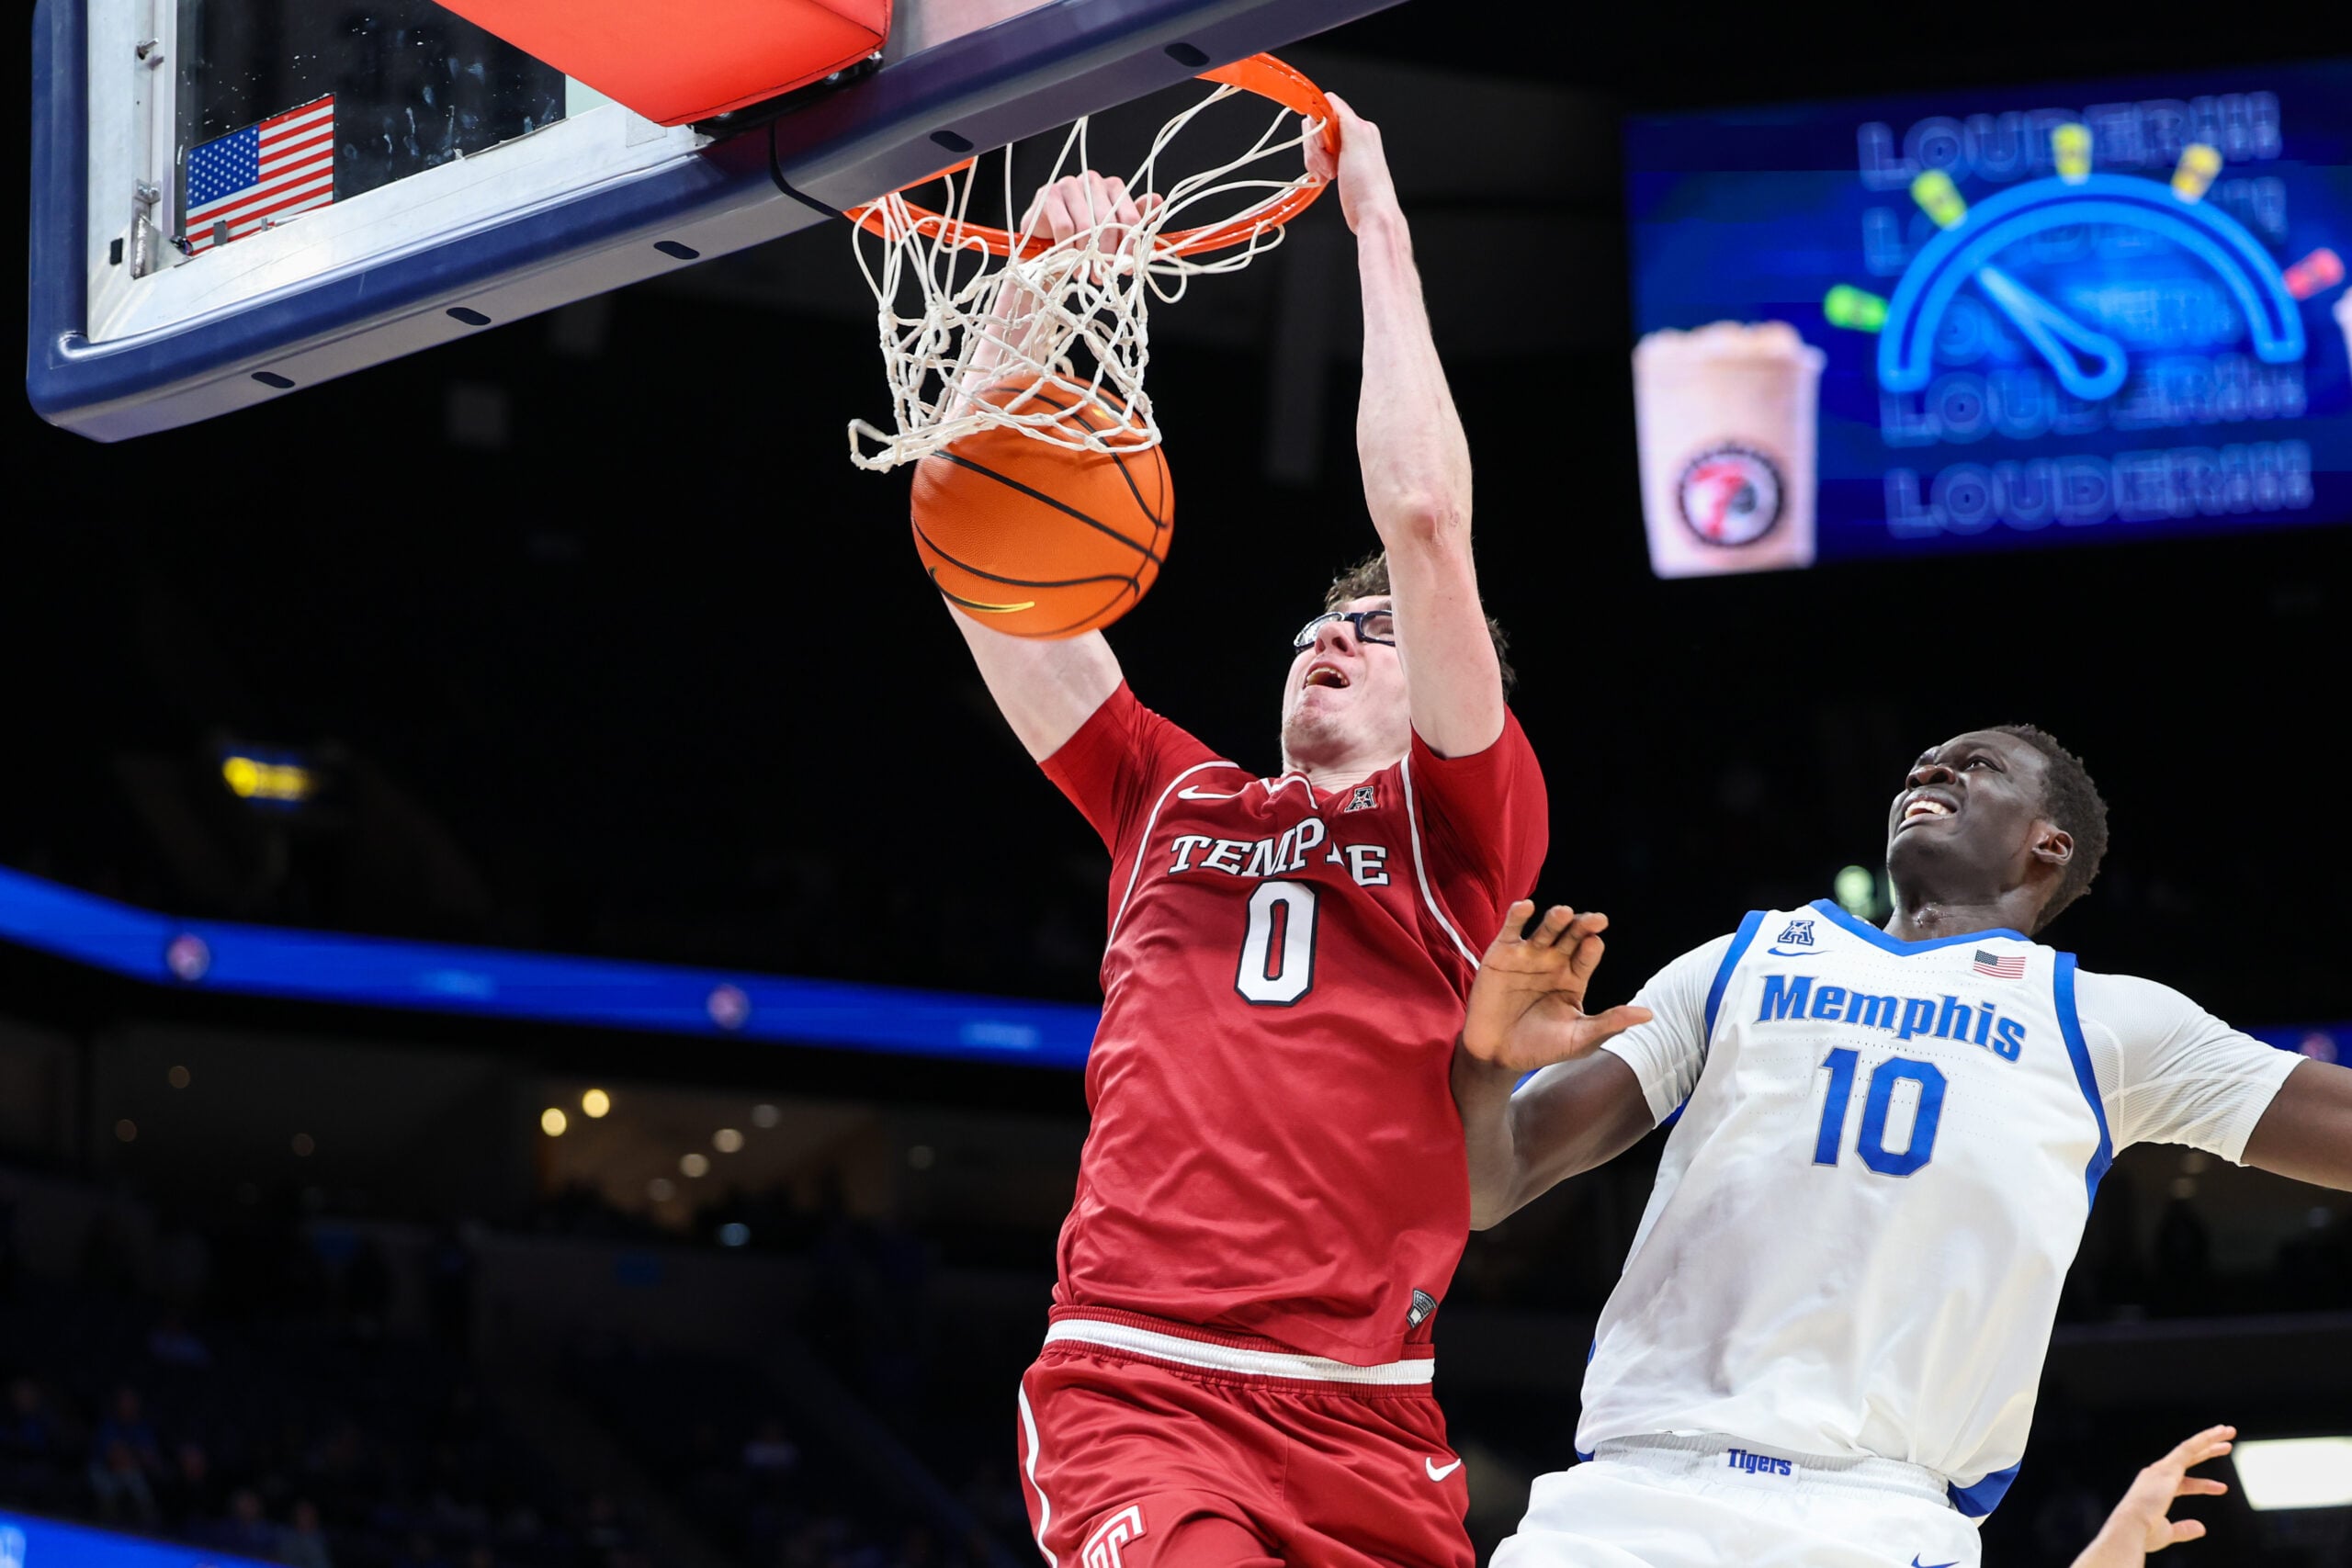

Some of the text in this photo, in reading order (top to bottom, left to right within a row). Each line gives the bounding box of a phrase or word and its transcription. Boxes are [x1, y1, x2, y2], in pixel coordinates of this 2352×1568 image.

[1234, 879, 1322, 1007] 0
[1752, 974, 2027, 1064] Memphis
[1812, 1045, 1949, 1179] 10
[1727, 1448, 1792, 1476] Tigers
